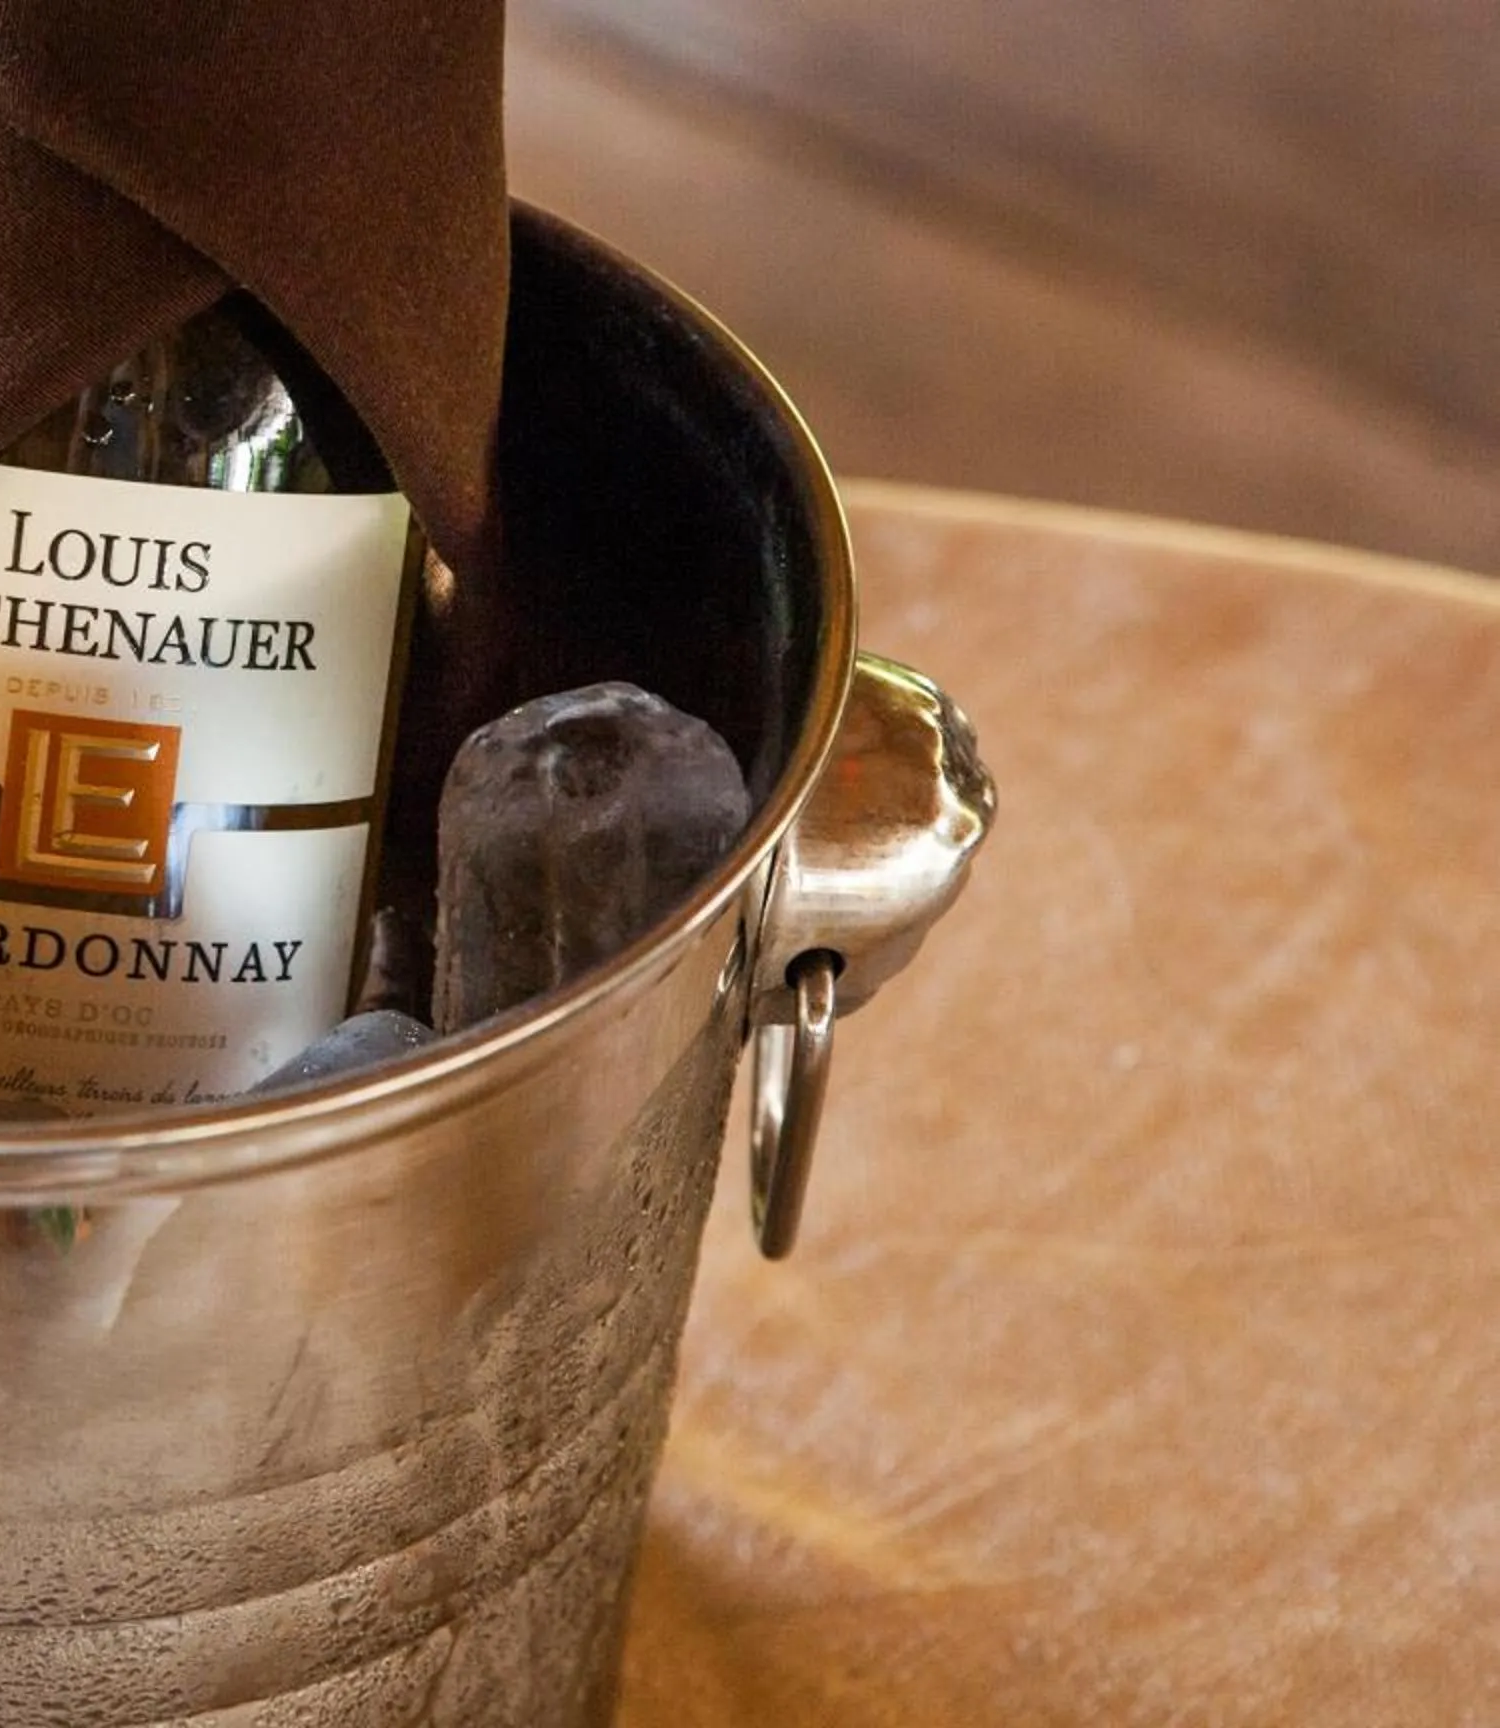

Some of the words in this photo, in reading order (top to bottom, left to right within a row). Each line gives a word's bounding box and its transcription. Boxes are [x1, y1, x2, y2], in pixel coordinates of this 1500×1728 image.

[4, 509, 211, 593] LOUIS
[6, 675, 110, 706] DEPUIS
[78, 1001, 155, 1028] D'OC
